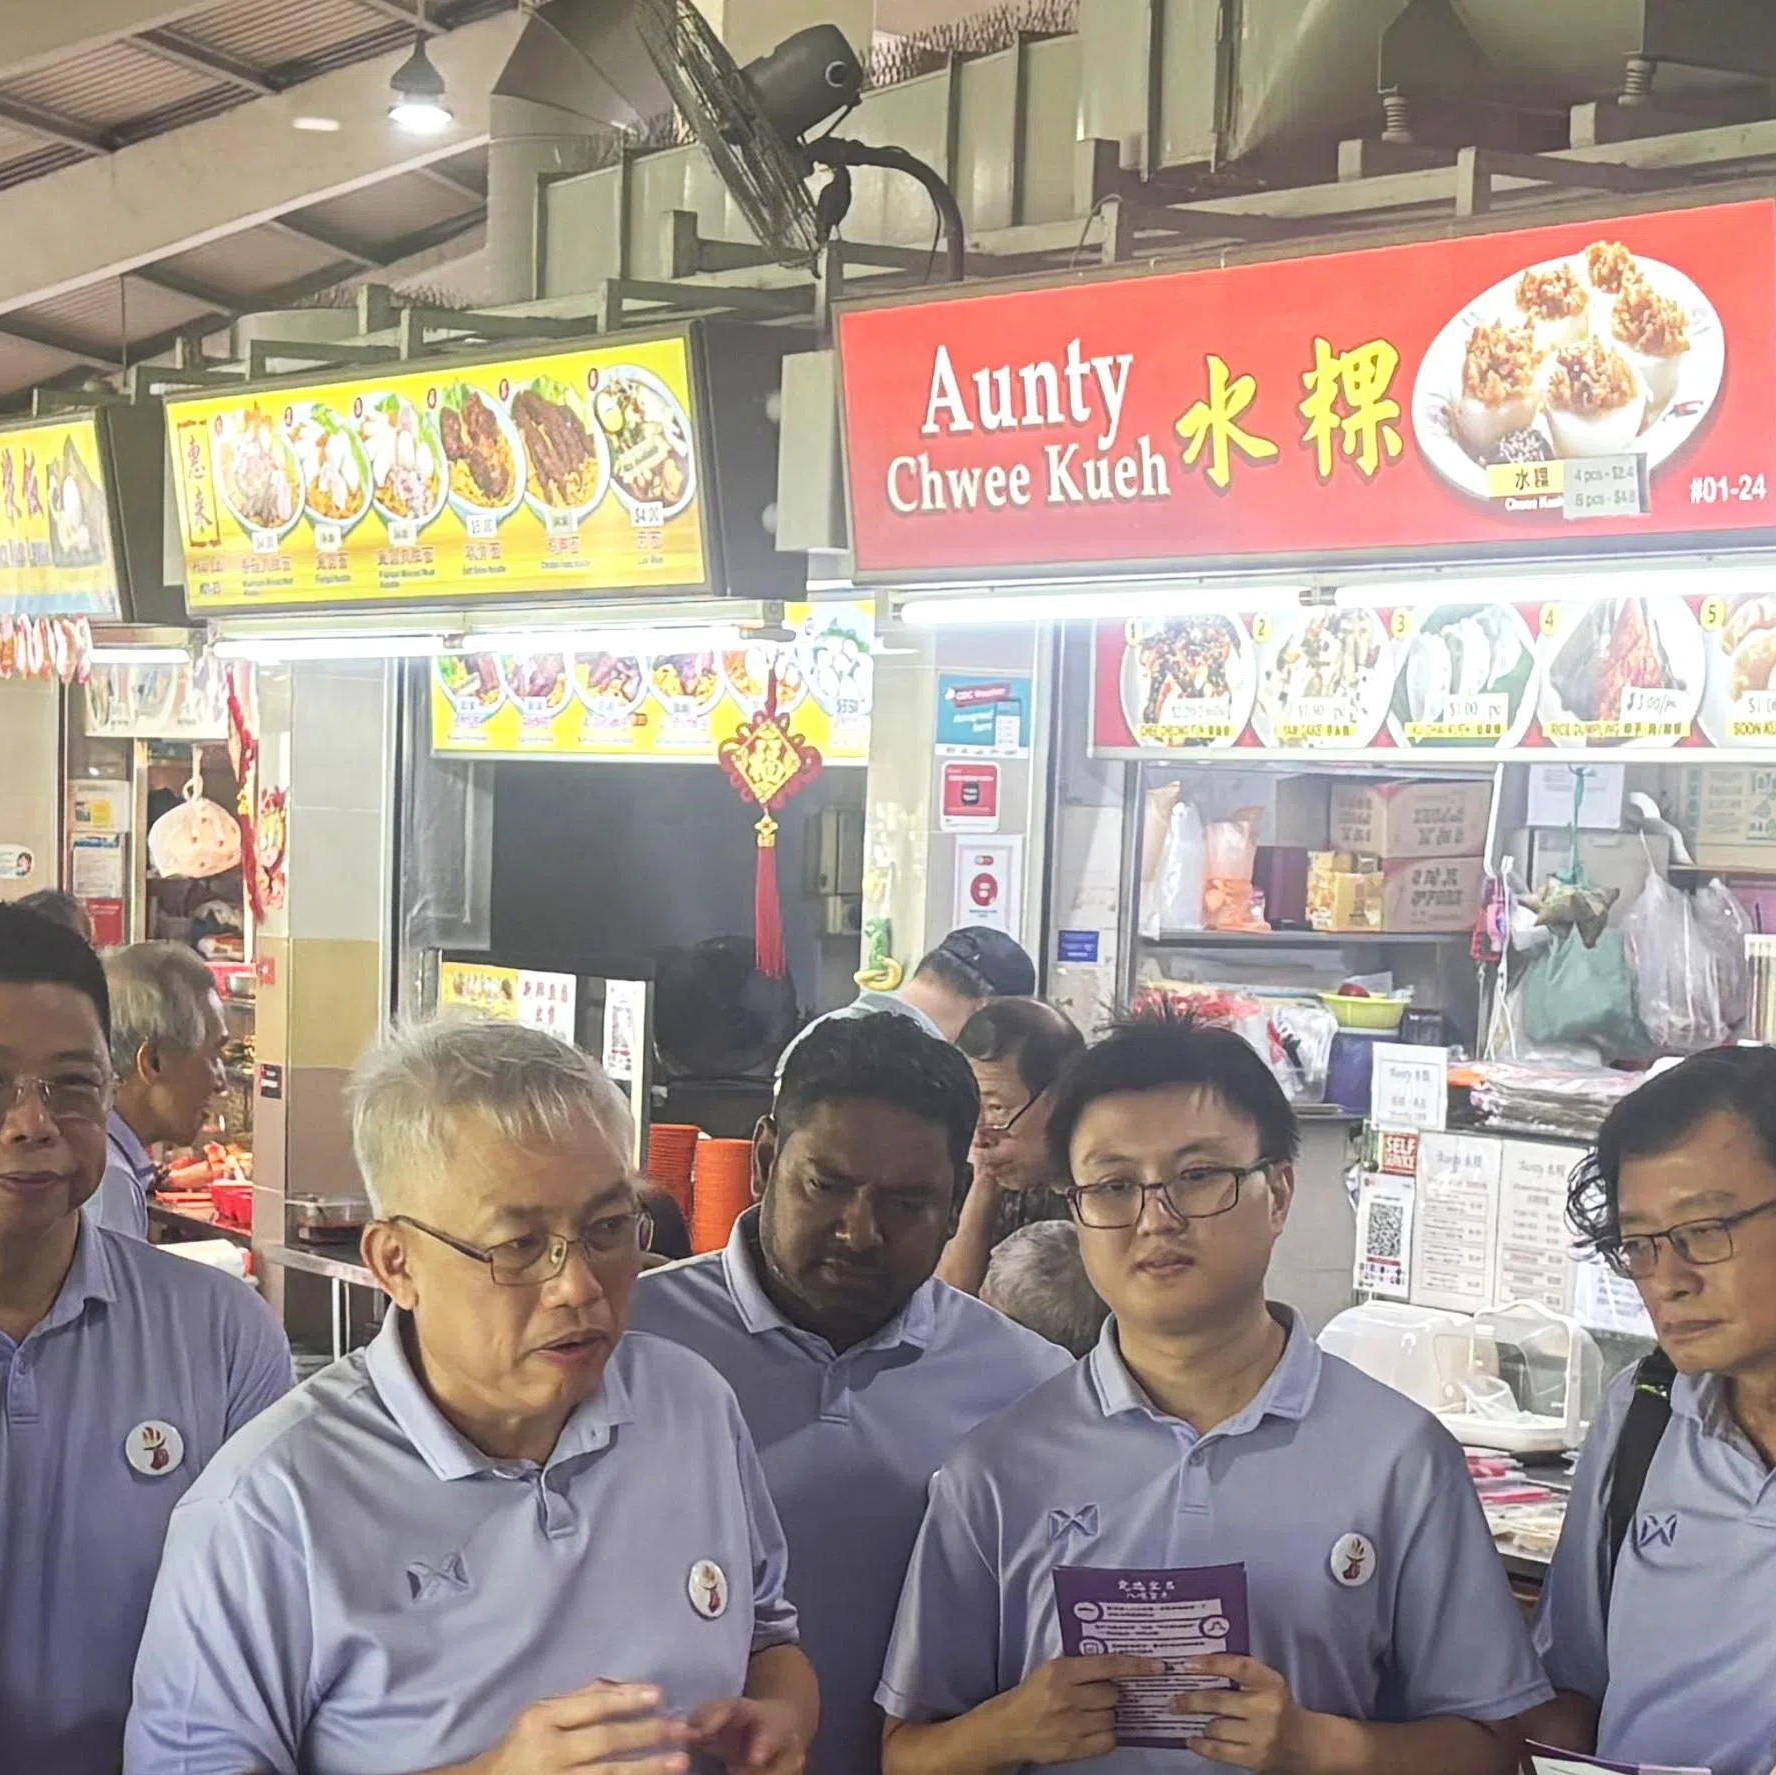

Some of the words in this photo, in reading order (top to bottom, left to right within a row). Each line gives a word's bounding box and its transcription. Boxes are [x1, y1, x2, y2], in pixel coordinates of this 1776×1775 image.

[921, 337, 1133, 450] Aunty
[1175, 337, 1404, 488] 水粿
[886, 452, 1031, 513] Chwee
[1045, 435, 1171, 503] Kueh
[1689, 474, 1767, 504] #01-24
[1396, 614, 1405, 632] 3
[1545, 609, 1554, 628] 4
[1707, 605, 1716, 624] 5
[1257, 619, 1266, 637] 2
[1550, 724, 1572, 737] RICE
[1733, 721, 1762, 736] SOON
[1385, 1136, 1416, 1150] SELF
